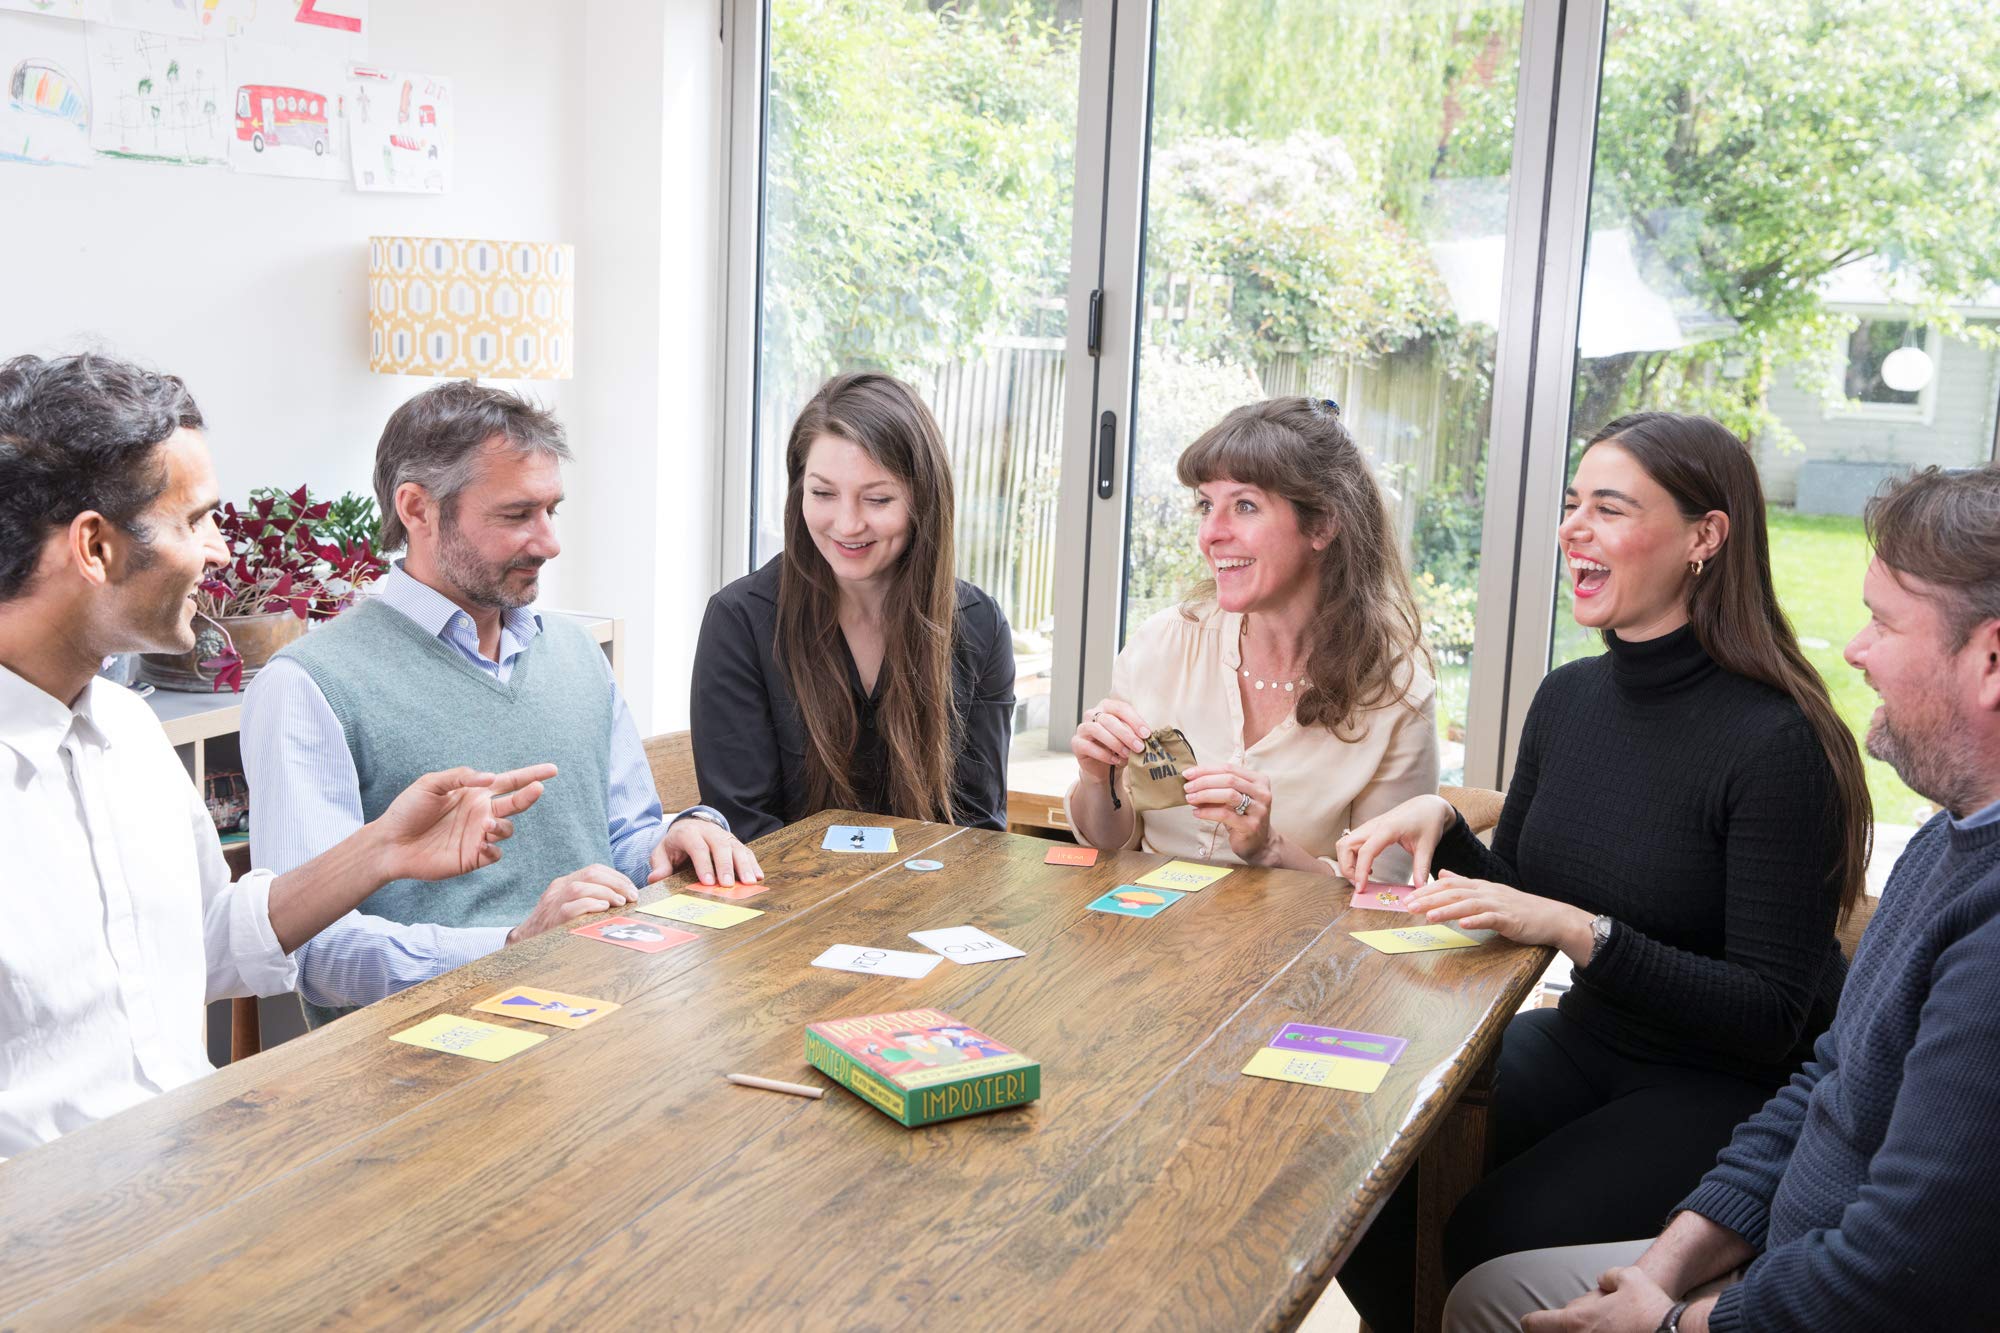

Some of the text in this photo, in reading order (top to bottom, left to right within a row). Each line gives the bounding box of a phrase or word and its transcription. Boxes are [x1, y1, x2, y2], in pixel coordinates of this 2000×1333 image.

[1149, 763, 1181, 781] MAI
[822, 1009, 947, 1040] IMPOSTER!
[805, 1032, 851, 1086] IMPOSTER!
[922, 1072, 1026, 1119] IMPOSTER!
